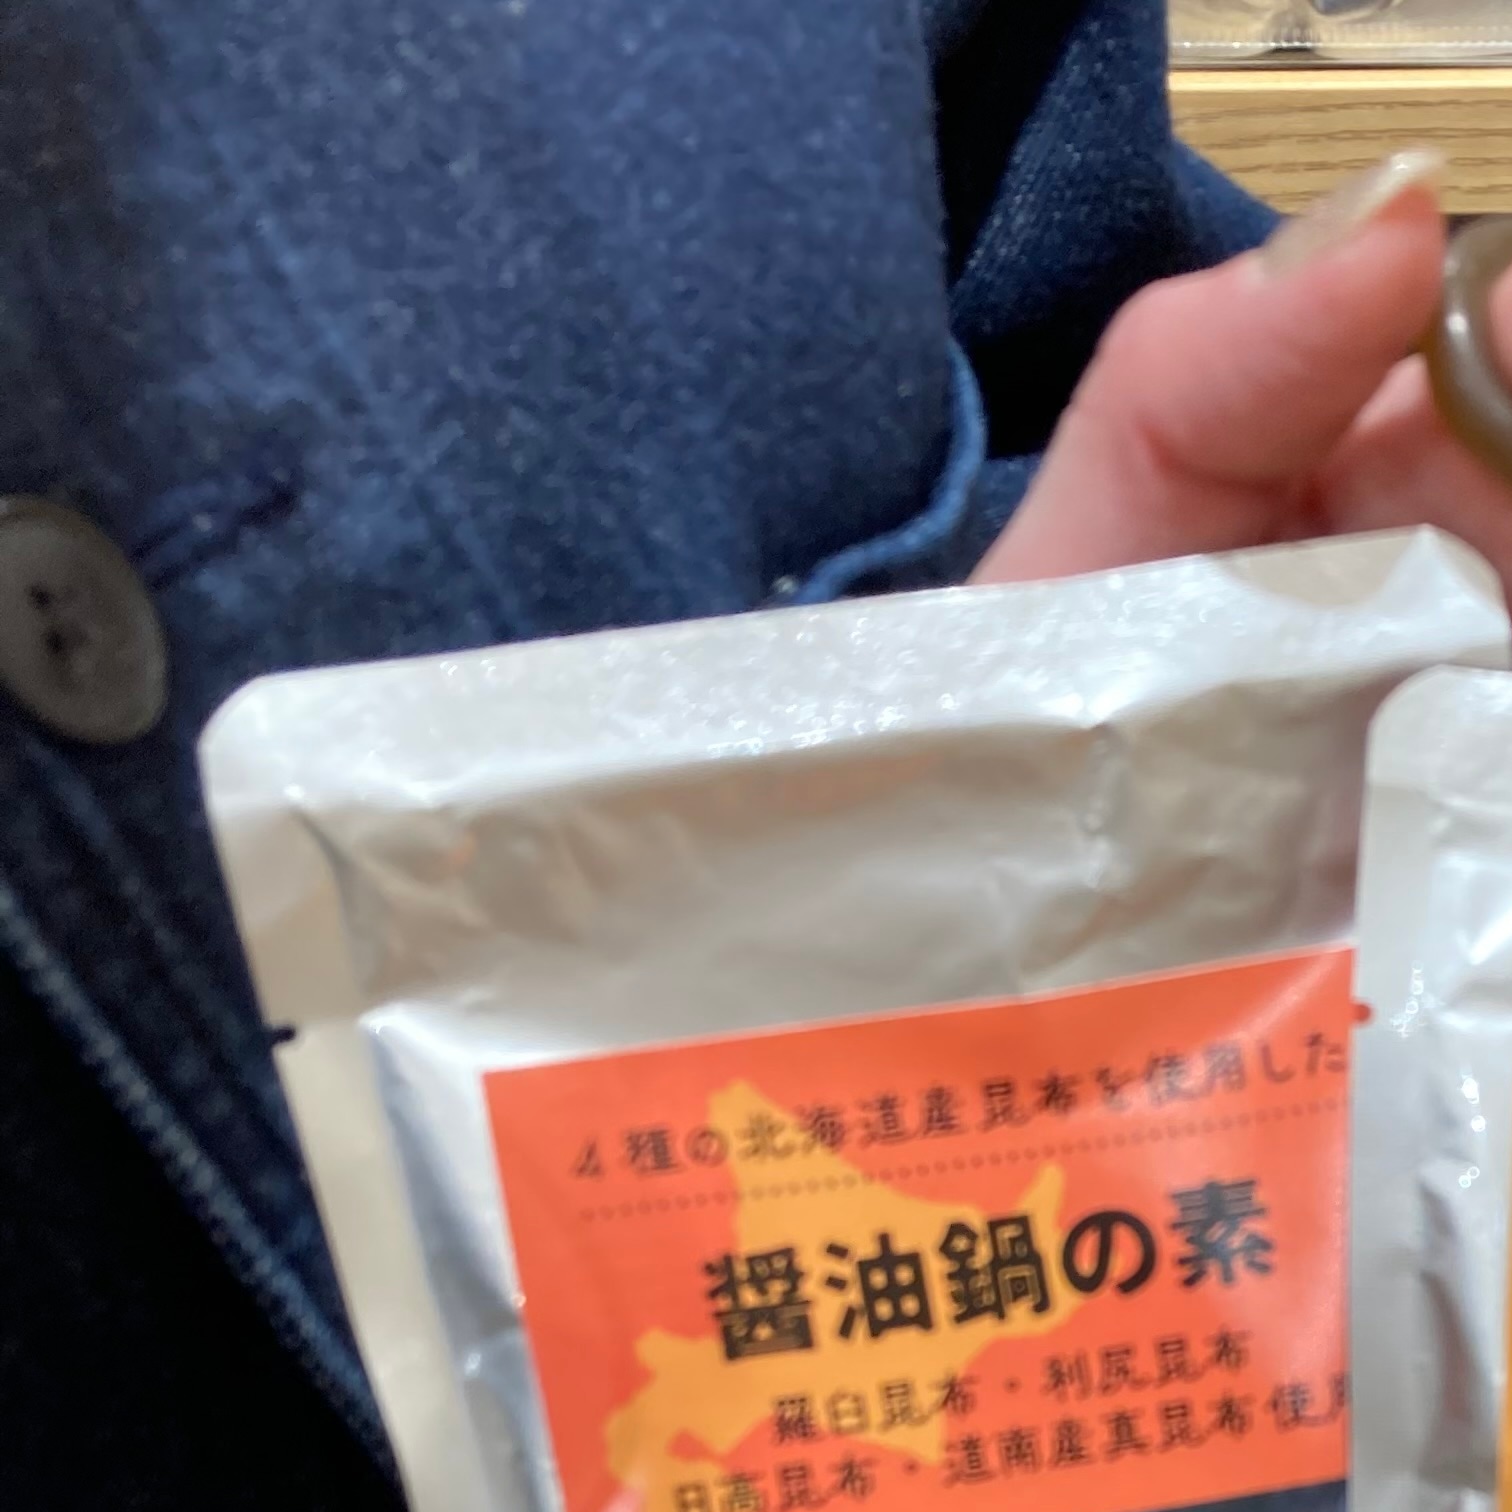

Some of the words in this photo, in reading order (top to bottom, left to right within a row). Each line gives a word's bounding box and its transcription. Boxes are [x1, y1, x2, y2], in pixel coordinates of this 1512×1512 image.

[701, 1175, 1276, 1363] 醤油鍋の素
